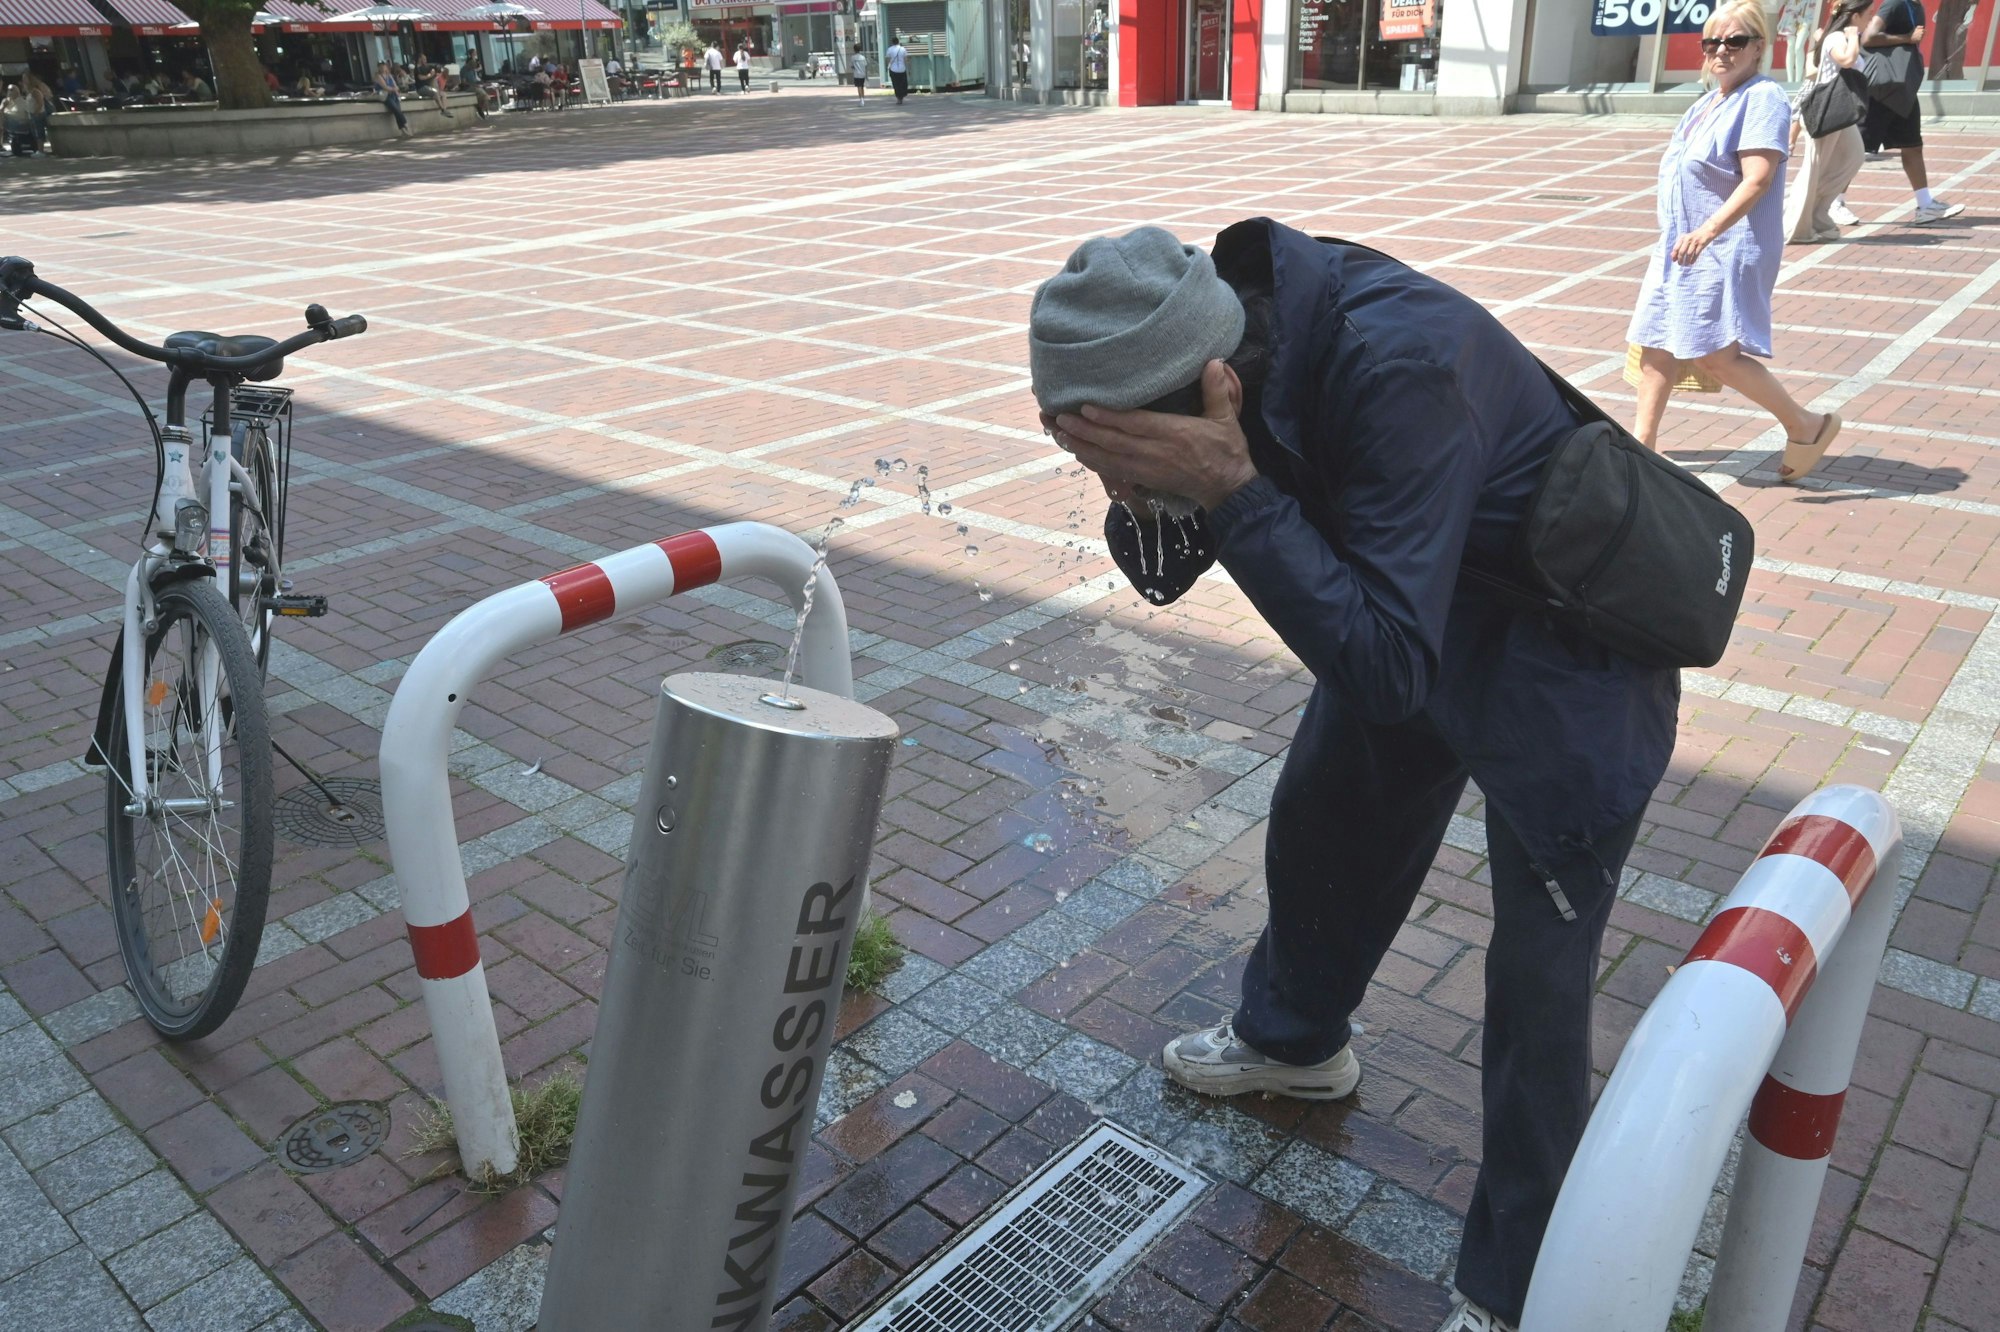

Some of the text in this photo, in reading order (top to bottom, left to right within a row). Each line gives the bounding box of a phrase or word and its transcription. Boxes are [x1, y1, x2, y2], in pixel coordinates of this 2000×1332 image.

[1392, 9, 1424, 18] FÜR DICH
[1385, 24, 1418, 35] SPAREN
[1715, 531, 1733, 597] Bench.
[681, 956, 715, 982] Sie.
